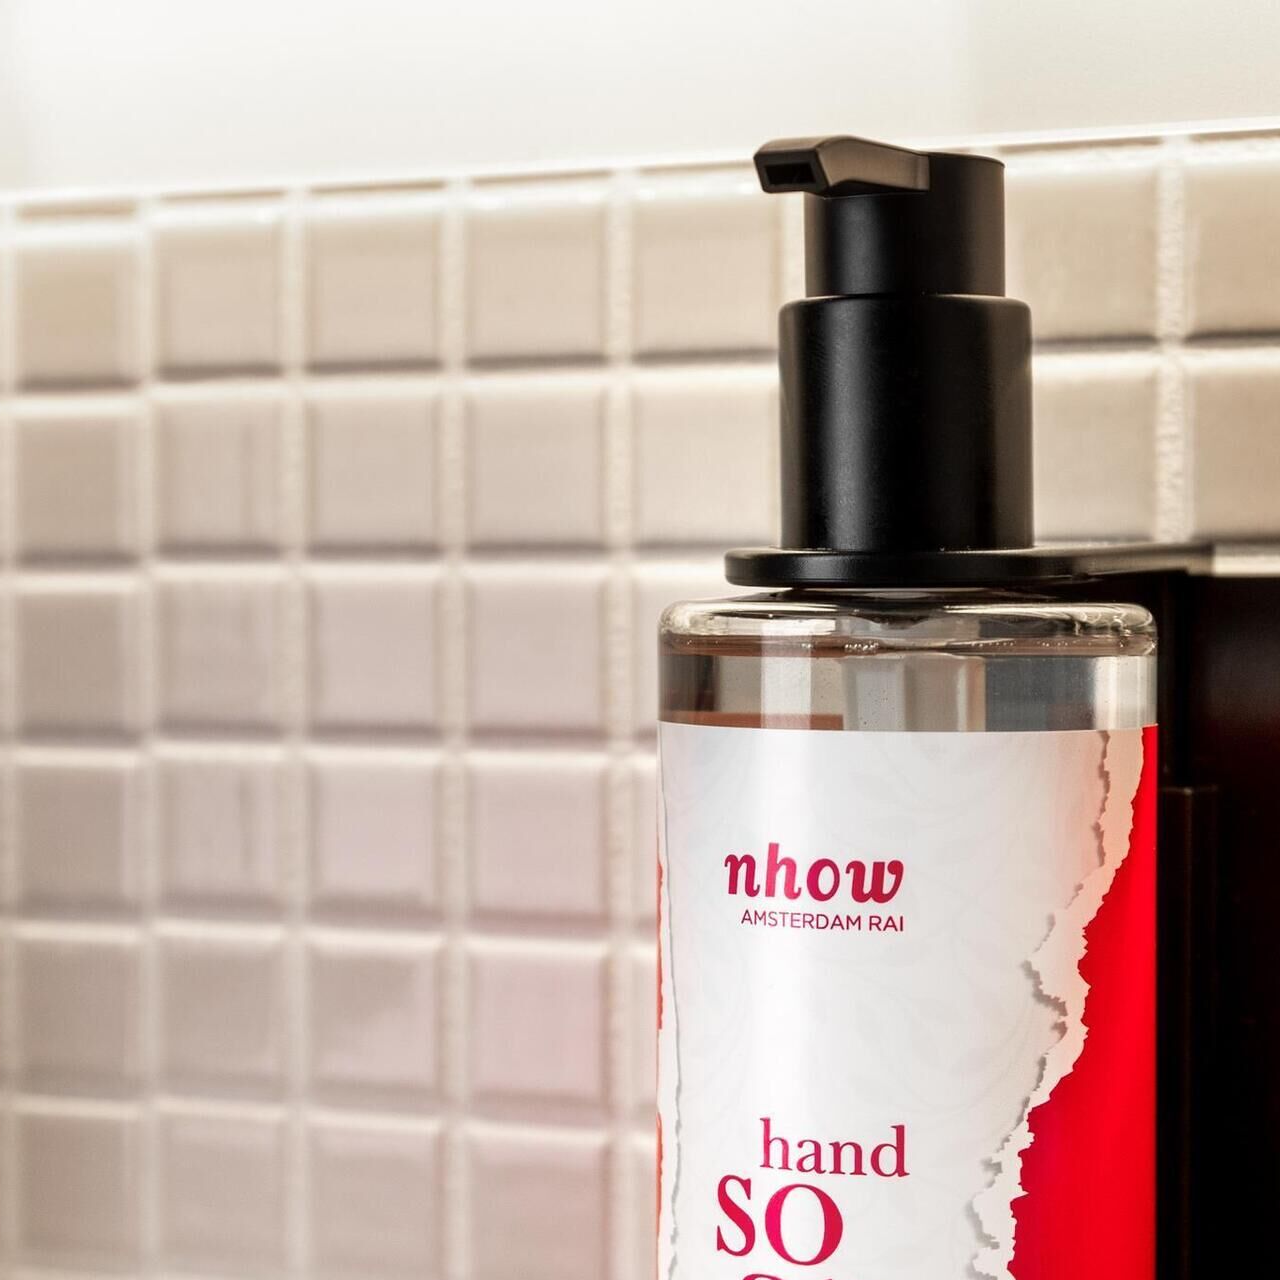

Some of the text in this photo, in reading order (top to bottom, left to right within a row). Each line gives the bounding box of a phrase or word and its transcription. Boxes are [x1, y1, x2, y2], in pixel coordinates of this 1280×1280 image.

[724, 842, 905, 905] nhow
[741, 909, 905, 932] AMSTERDAM RAI
[760, 1117, 909, 1178] hand
[716, 1174, 844, 1266] so
